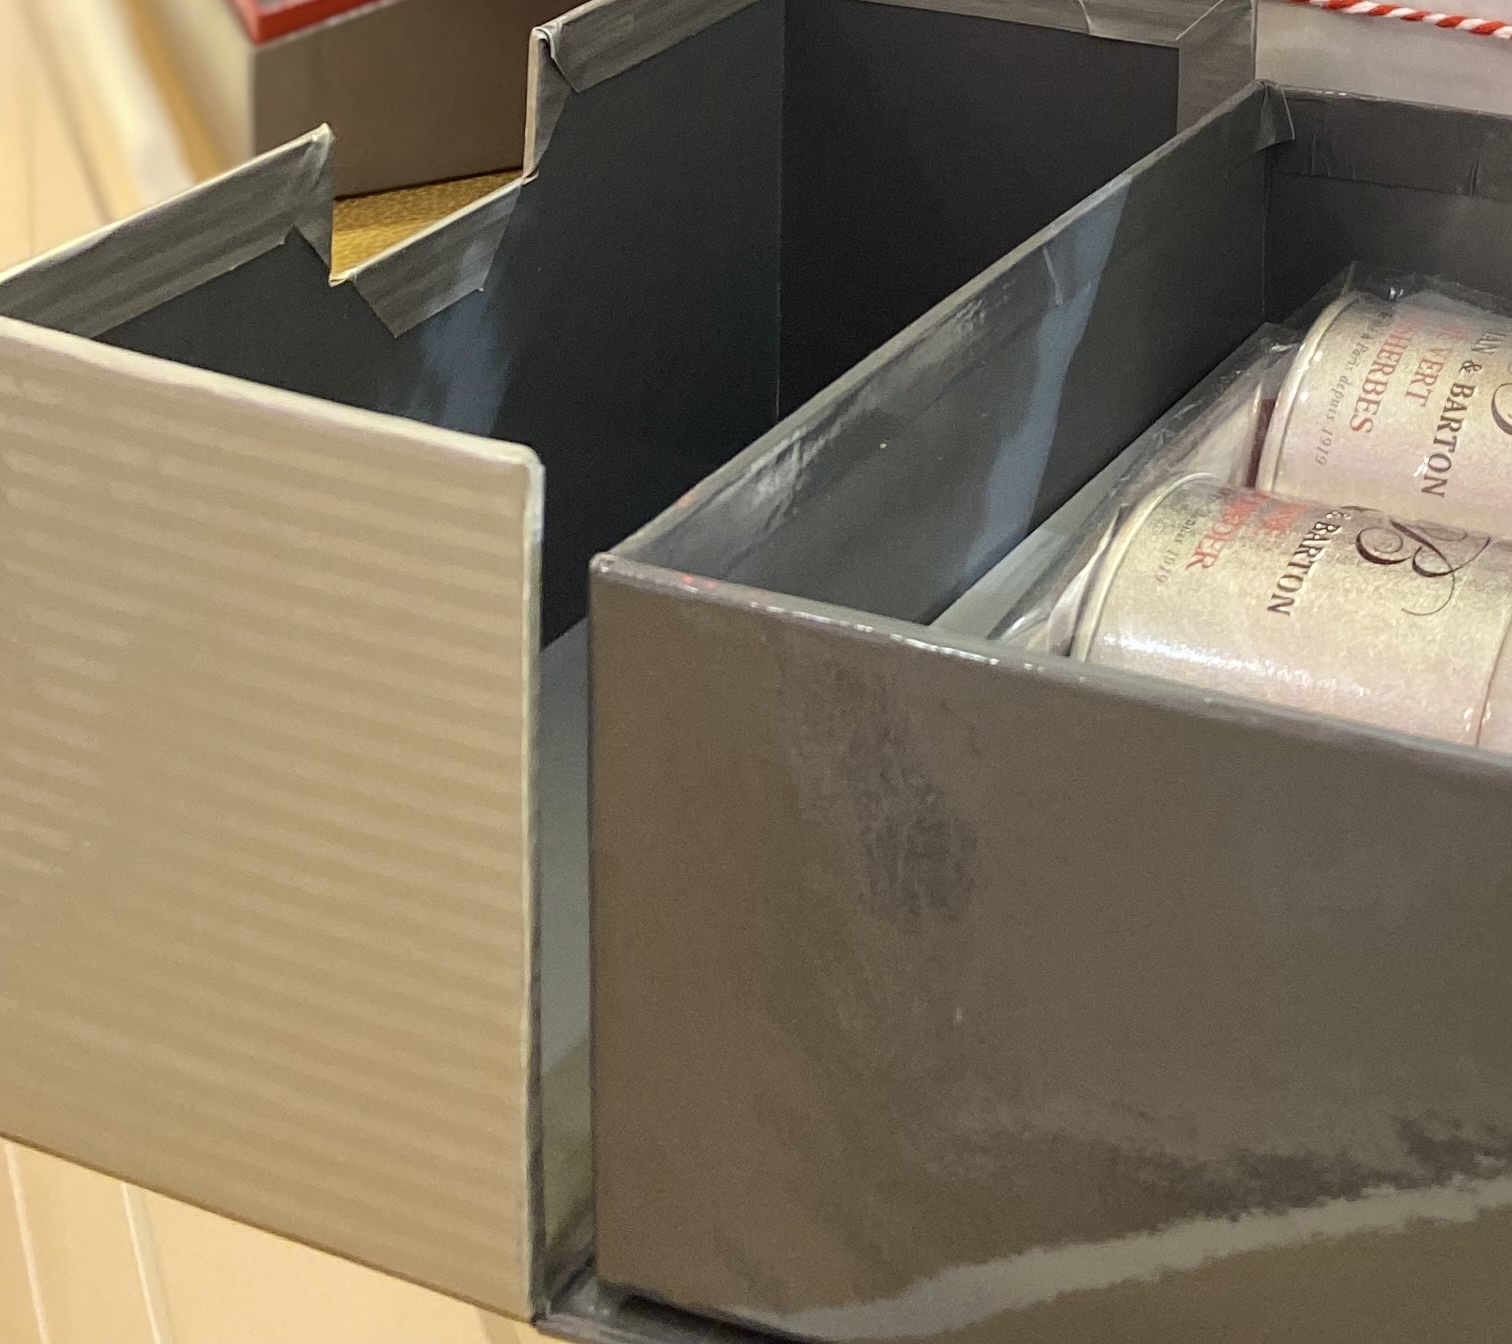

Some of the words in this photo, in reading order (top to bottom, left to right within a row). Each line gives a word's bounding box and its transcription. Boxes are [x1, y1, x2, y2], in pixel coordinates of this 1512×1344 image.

[1405, 348, 1453, 407] VERT
[1421, 382, 1476, 498] BARTON
[1267, 521, 1341, 616] BARTON
